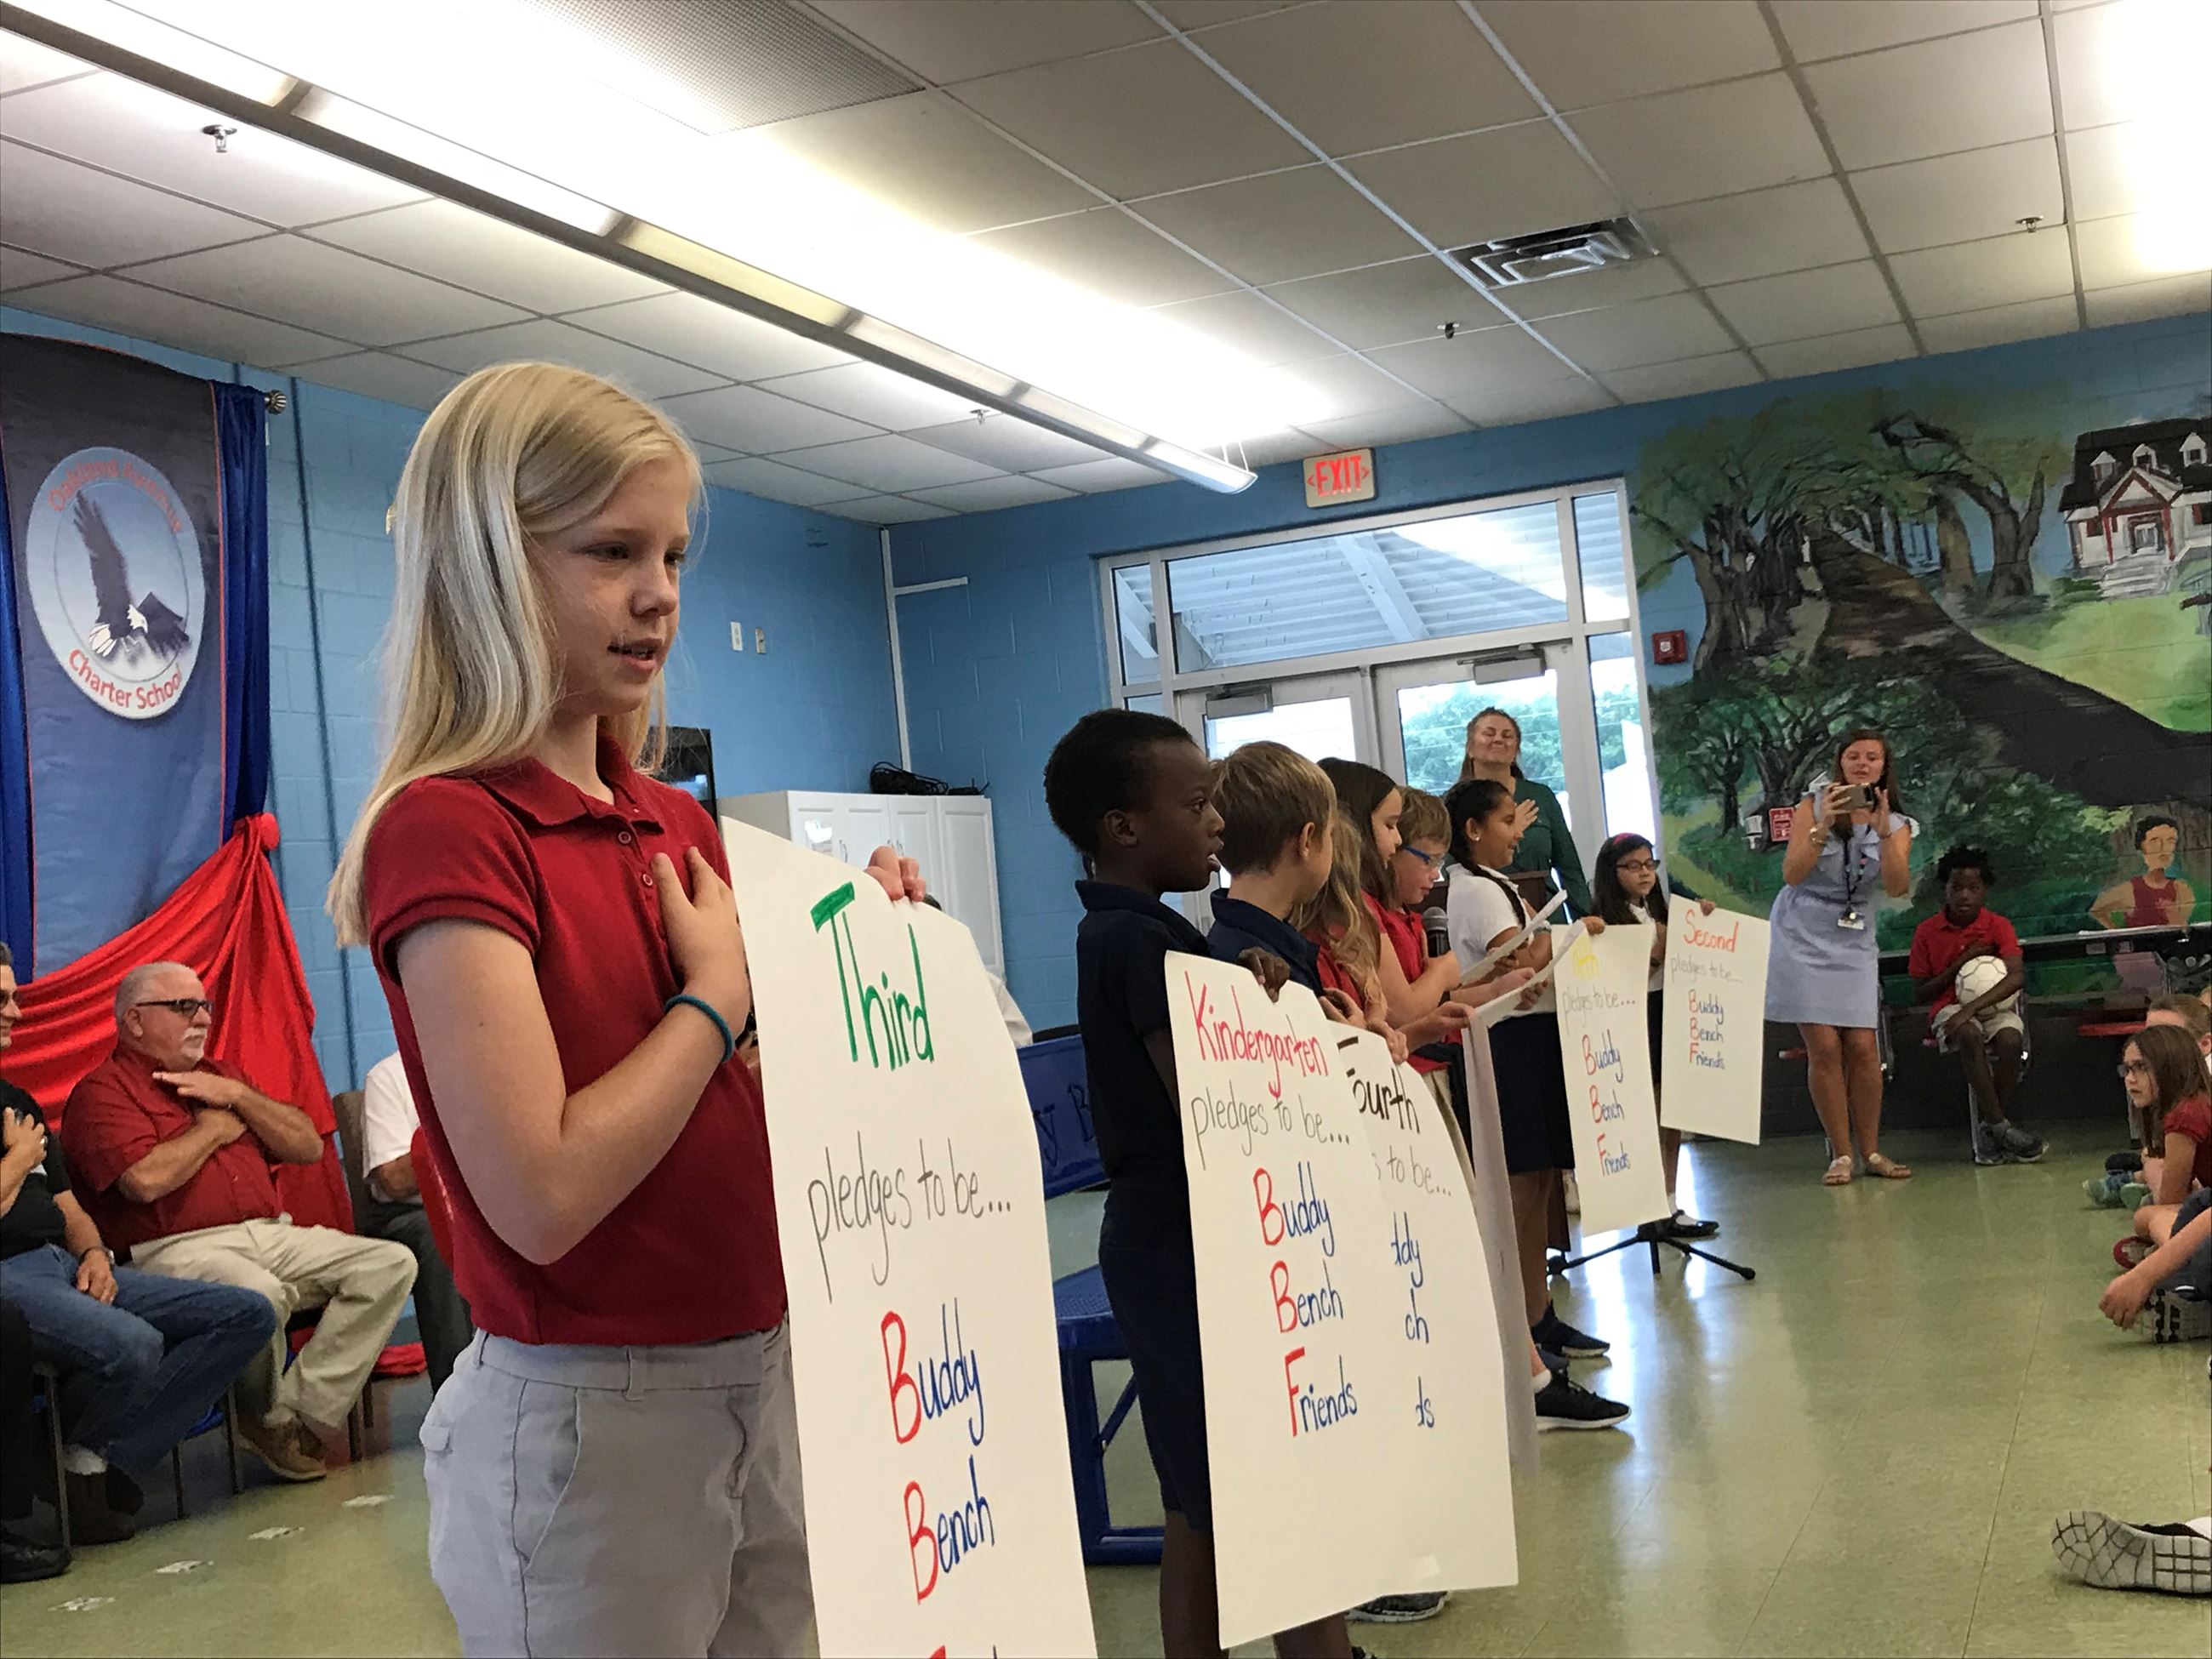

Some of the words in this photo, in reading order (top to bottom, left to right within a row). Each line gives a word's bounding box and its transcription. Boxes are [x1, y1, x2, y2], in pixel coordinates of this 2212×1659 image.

[48, 459, 119, 512] Oakland
[1314, 454, 1362, 498] EXIT
[69, 648, 133, 708] Charter
[136, 663, 183, 709] School
[1683, 909, 1739, 953] Second
[811, 881, 934, 1071] Third
[1184, 970, 1328, 1098] Kindergarten
[1688, 989, 1724, 1025] Buddy
[1690, 1017, 1724, 1043] Bench
[1582, 1029, 1623, 1083] Buddy
[1689, 1043, 1725, 1071] Friends
[1191, 1080, 1269, 1171] pledges
[1274, 1097, 1292, 1132] to
[1589, 1085, 1624, 1124] Bench
[1387, 1145, 1405, 1183] to
[1597, 1133, 1630, 1177] Friends
[808, 1131, 912, 1303] pledges
[918, 1138, 945, 1221] to
[1252, 1161, 1335, 1257] Buddy
[1269, 1259, 1343, 1334] Bench
[881, 1297, 985, 1446] Buddy
[1284, 1347, 1358, 1438] Friends
[904, 1455, 995, 1605] Bench
